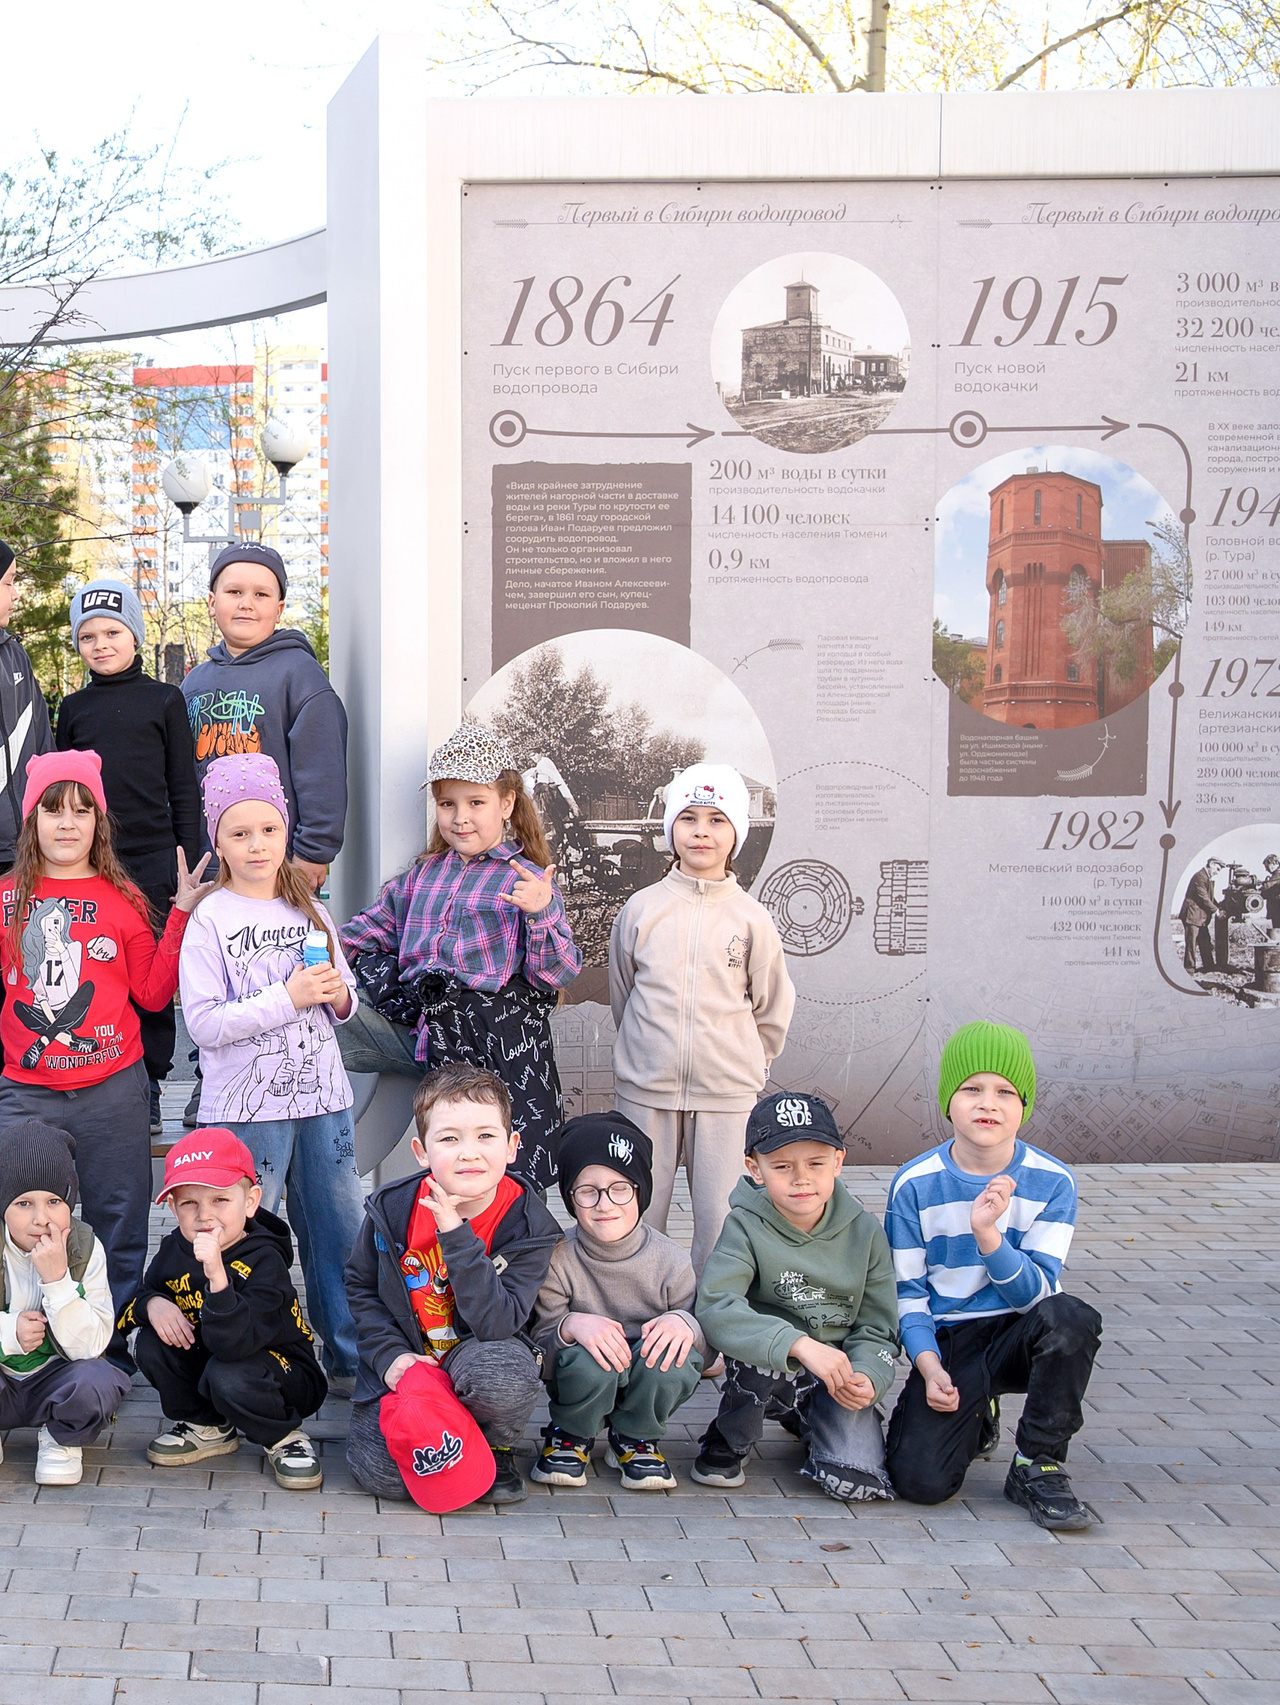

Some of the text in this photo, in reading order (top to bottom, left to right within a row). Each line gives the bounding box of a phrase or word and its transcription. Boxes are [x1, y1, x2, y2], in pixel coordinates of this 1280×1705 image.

[556, 201, 847, 227] Первый в Сибири водопровод
[1021, 200, 1104, 227] Первый
[1109, 212, 1119, 222] в
[1124, 201, 1199, 227] Сибири
[1177, 273, 1189, 293] 3
[1197, 272, 1240, 293] 000
[490, 274, 681, 347] 1864
[948, 274, 1129, 347] 1915
[1176, 317, 1204, 338] 32
[1210, 317, 1254, 338] 200
[493, 362, 678, 378] Пуск первого в Сибири
[955, 361, 1046, 377] Пуск новой
[1175, 362, 1228, 382] 21 км
[493, 384, 598, 396] водопровода
[954, 382, 1038, 394] водокачки
[709, 459, 752, 480] 200
[782, 469, 822, 482] воды
[828, 469, 836, 479] в
[841, 469, 886, 484] сутки
[506, 481, 643, 491] «Видя крайнее затруднение
[709, 486, 885, 496] производительность водокачки
[506, 492, 548, 500] жителей
[550, 492, 596, 502] нагорной
[506, 504, 530, 512] воды
[546, 504, 570, 512] реки
[572, 502, 596, 512] Туры
[613, 504, 656, 512] крутости
[506, 513, 546, 523] берега»,
[556, 513, 574, 521] 1861
[577, 514, 598, 523] году
[600, 513, 651, 522] городской
[711, 504, 850, 524] 14 100 человек
[541, 524, 565, 532] Иван
[568, 524, 615, 533] Подаруев
[617, 525, 672, 533] предложил
[708, 529, 887, 539] численность населения Тюмени
[505, 535, 619, 544] соорудить водопровод.
[505, 545, 519, 553] Он
[570, 546, 632, 554] организовал
[505, 557, 577, 565] строительство,
[709, 549, 770, 572] 0,9 км
[1205, 550, 1255, 563] (р. Тура)
[544, 566, 607, 576] сбережения.
[505, 580, 532, 589] Дело,
[575, 580, 612, 588] Иваном
[708, 576, 869, 584] протяженность водопровода
[84, 592, 122, 609] UFC
[505, 592, 526, 600] чем,
[528, 592, 577, 600] завершил
[620, 591, 652, 600] купец-
[505, 601, 649, 610] меценат Прокопий Подаруев.
[1037, 811, 1144, 851] 1982
[989, 862, 1144, 875] Метелевский водозабор
[1093, 877, 1142, 889] (р. Тура)
[1064, 895, 1086, 907] 000
[1113, 898, 1143, 910] сутки
[3, 899, 98, 927] POER
[1075, 921, 1096, 931] 000
[1127, 949, 1140, 957] км
[45, 959, 65, 987] 17
[93, 1024, 114, 1037] YOU
[44, 1045, 125, 1071] WONDERFUL
[775, 1098, 809, 1114] OUT
[777, 1111, 813, 1127] SIDE
[173, 1150, 213, 1168] SANY
[413, 1430, 462, 1476] Next
